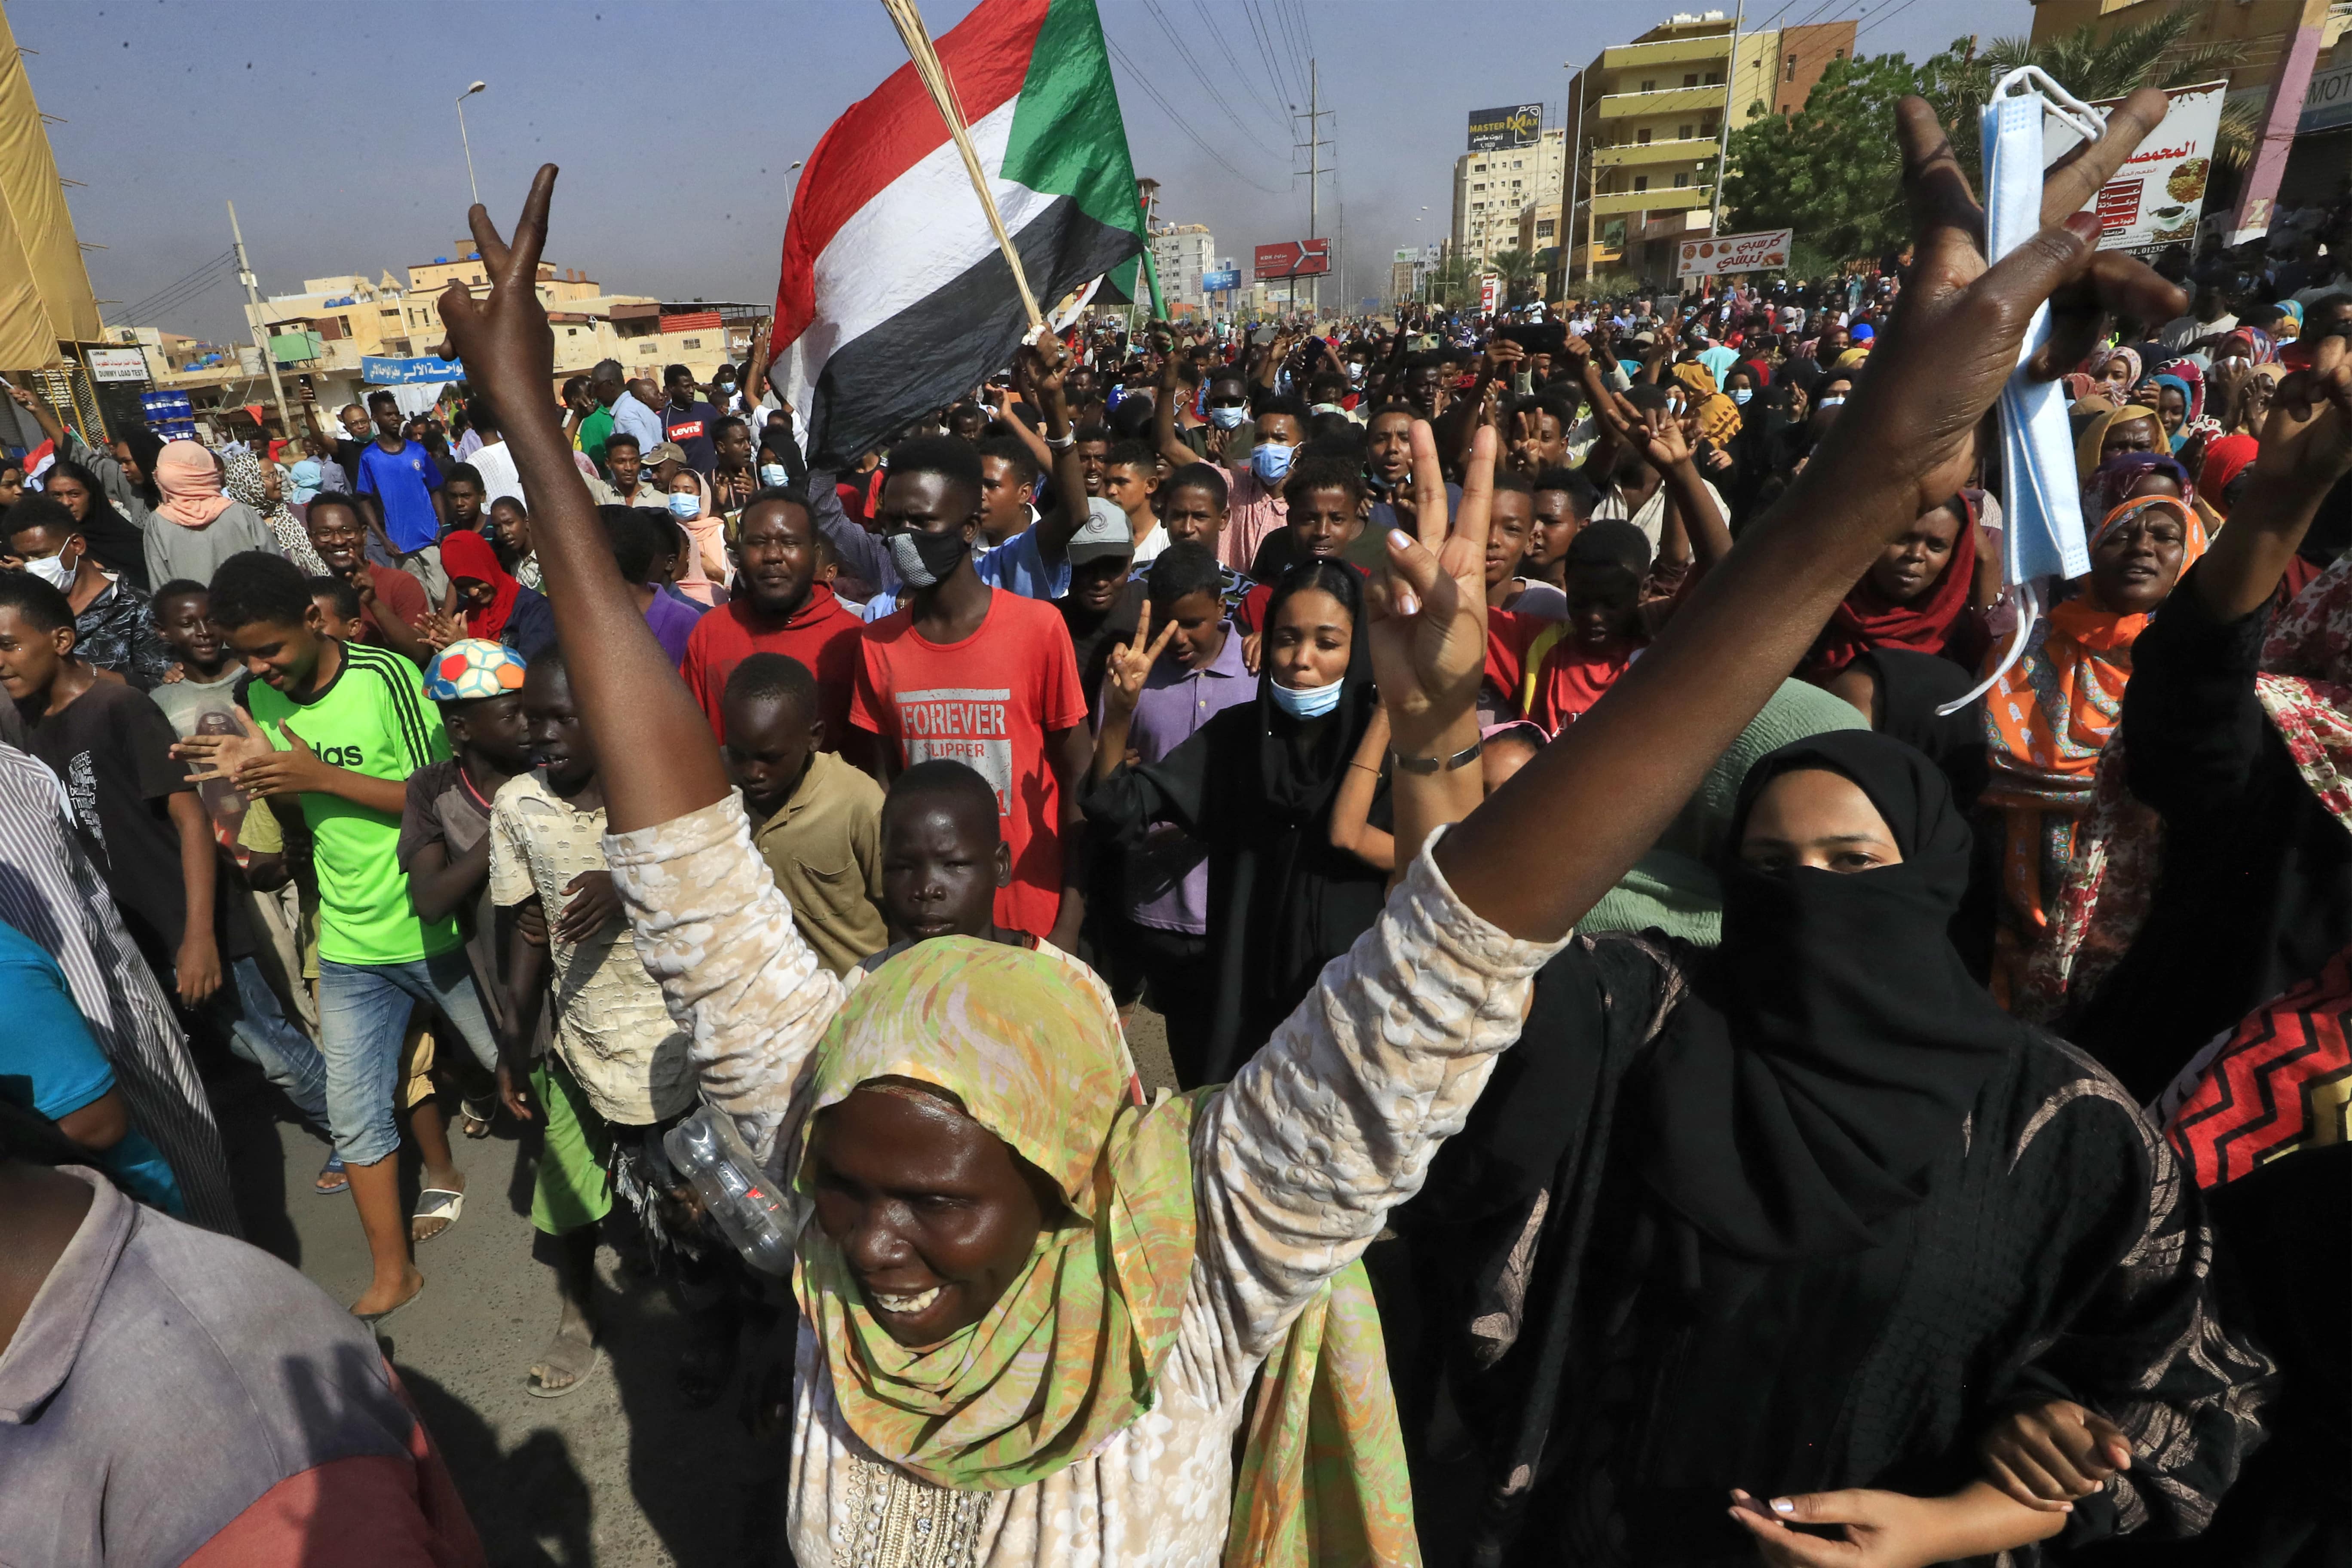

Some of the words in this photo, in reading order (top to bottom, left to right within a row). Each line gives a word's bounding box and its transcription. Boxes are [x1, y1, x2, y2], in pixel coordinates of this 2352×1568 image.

[1470, 122, 1504, 133] MASTER
[1506, 114, 1538, 136] MAX
[1473, 134, 1489, 143] ماستر
[2119, 216, 2135, 225] قهوة
[428, 362, 464, 376] لواحة
[901, 703, 1006, 735] FOREVER
[923, 743, 985, 758] SLIPPER
[70, 750, 92, 771] THERE
